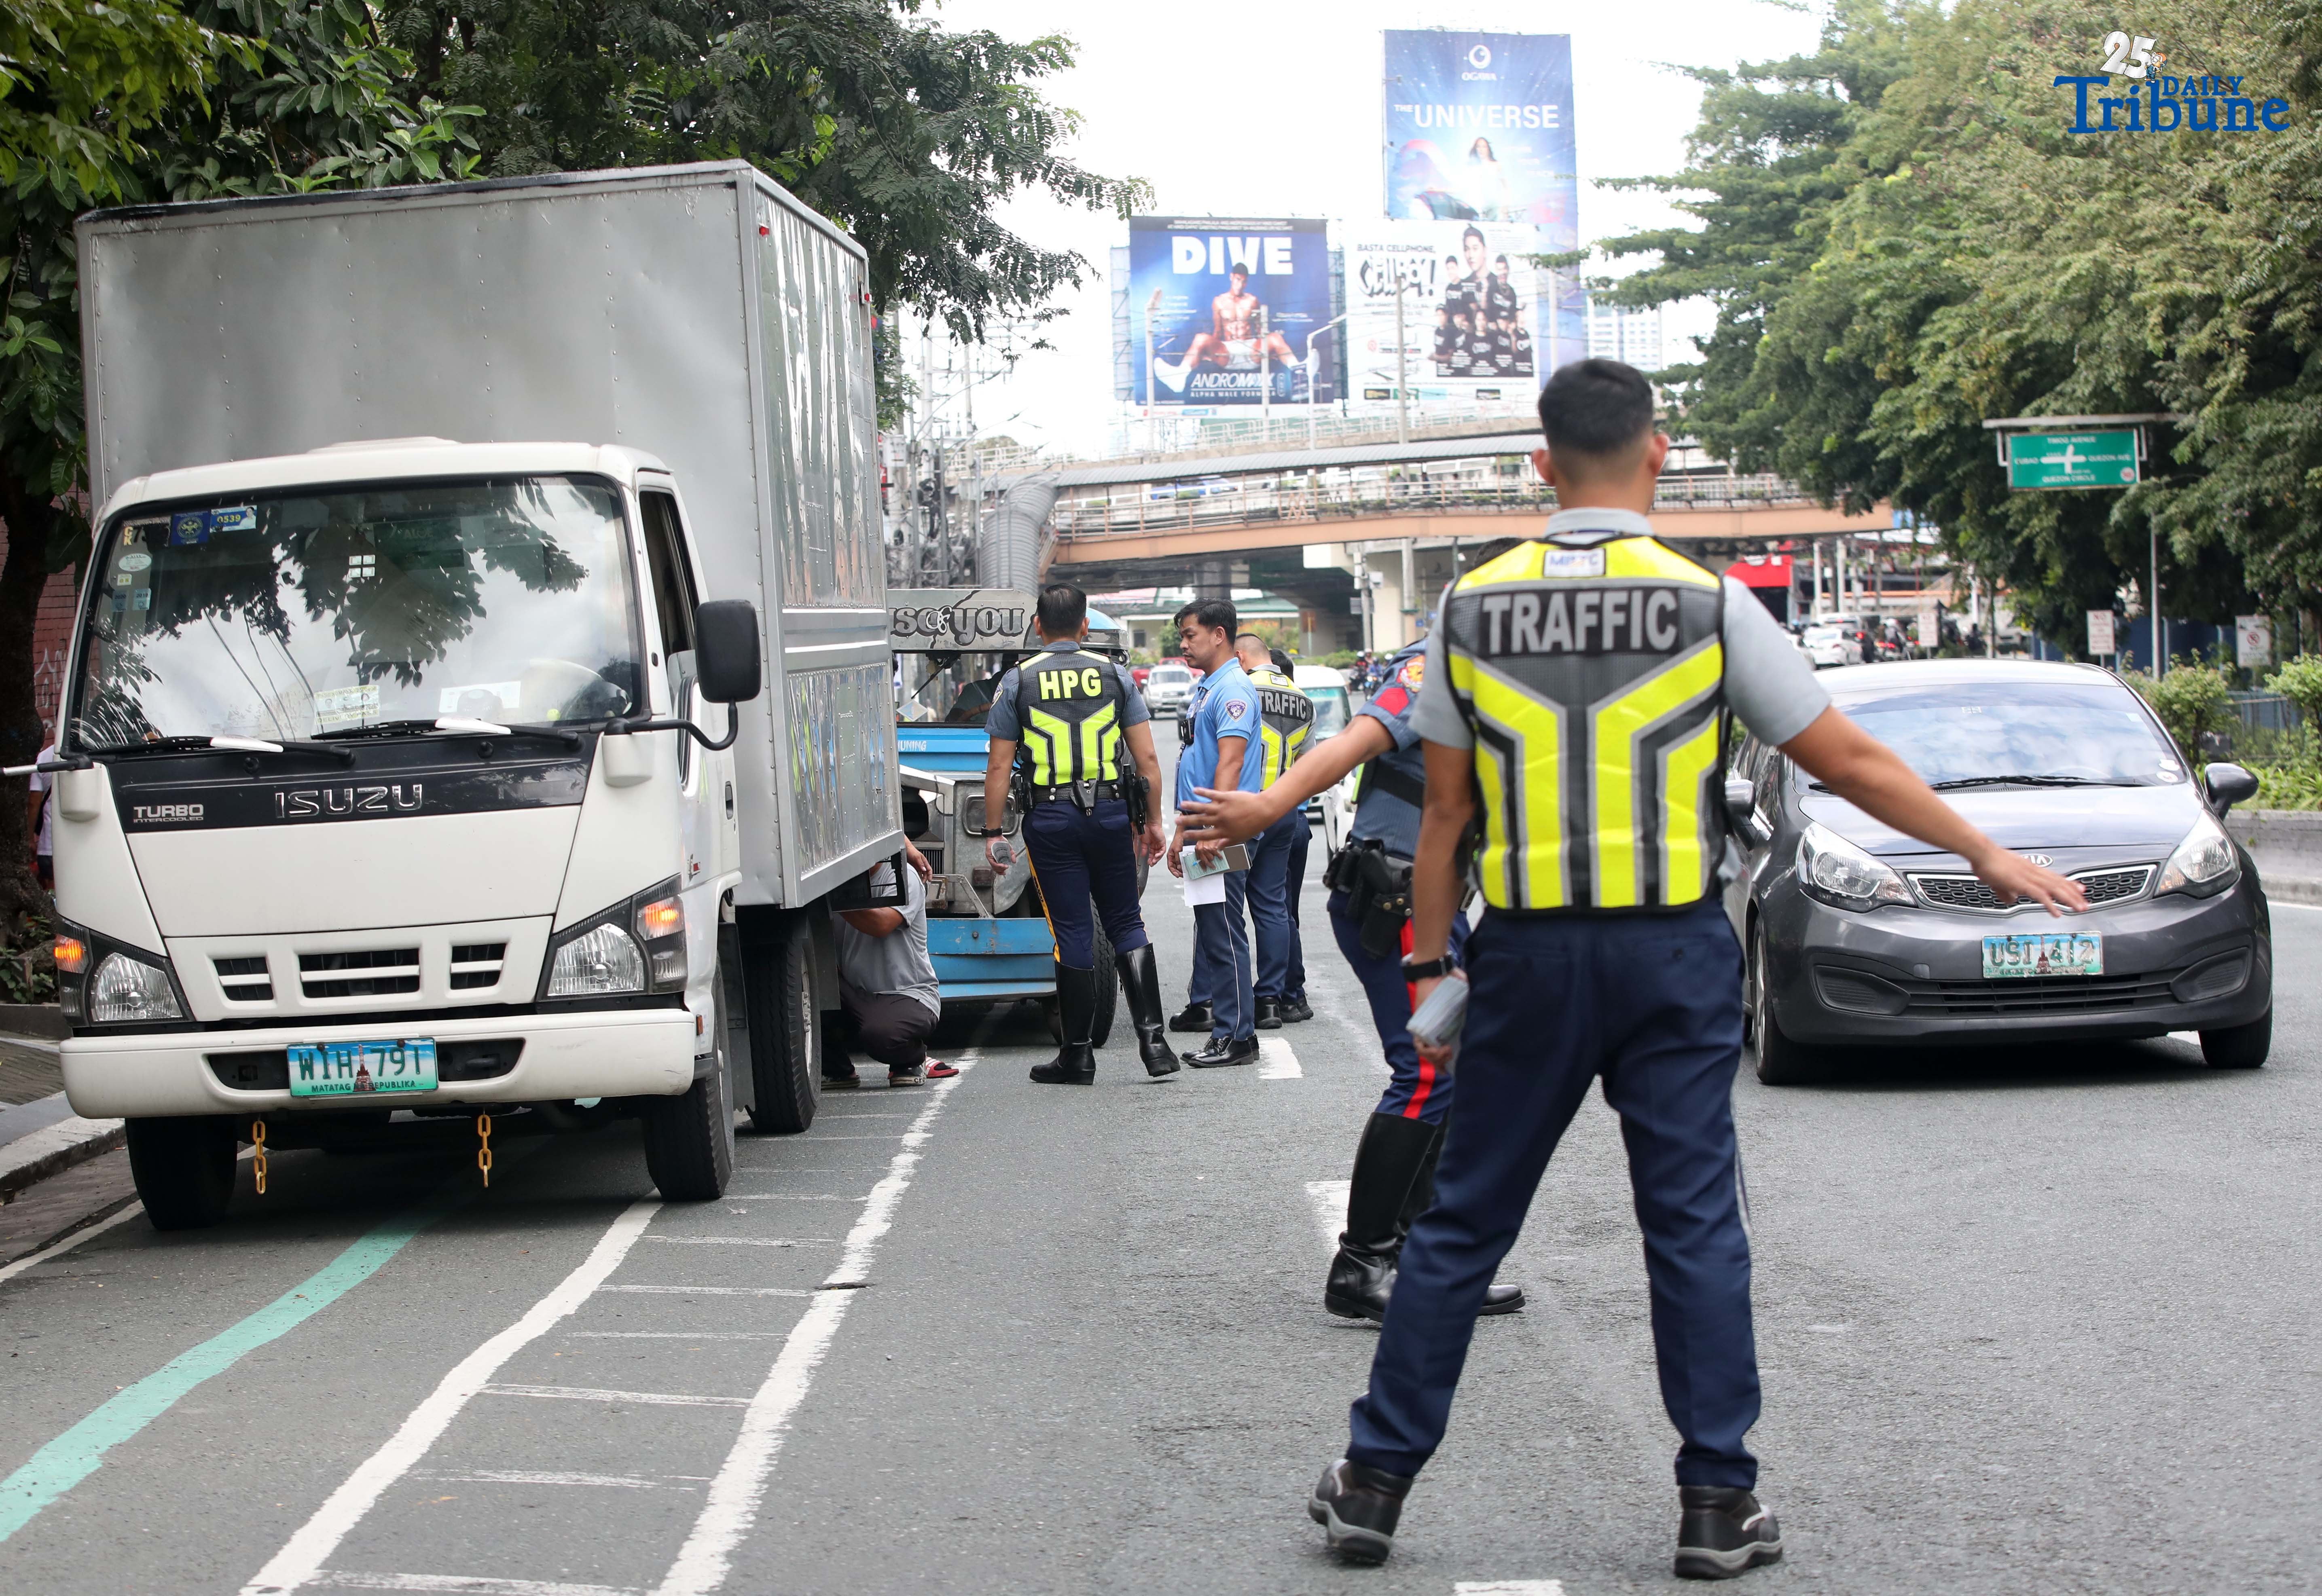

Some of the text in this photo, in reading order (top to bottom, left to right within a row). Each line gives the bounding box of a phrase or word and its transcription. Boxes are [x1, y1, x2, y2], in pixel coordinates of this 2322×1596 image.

[1394, 104, 1560, 129] THE UNIVERSE
[1172, 236, 1293, 275] DIVE
[1482, 589, 1678, 655] TRAFFIC
[1039, 668, 1101, 700] HPG
[1257, 691, 1306, 720] TRAFFIC
[133, 804, 204, 818] TURBO
[275, 783, 423, 818] ISUZU
[2050, 938, 2094, 965] 412
[298, 1046, 421, 1080] WIH 791
[311, 1083, 351, 1092] MATATAG
[369, 1080, 416, 1089] REPUBLIKA
